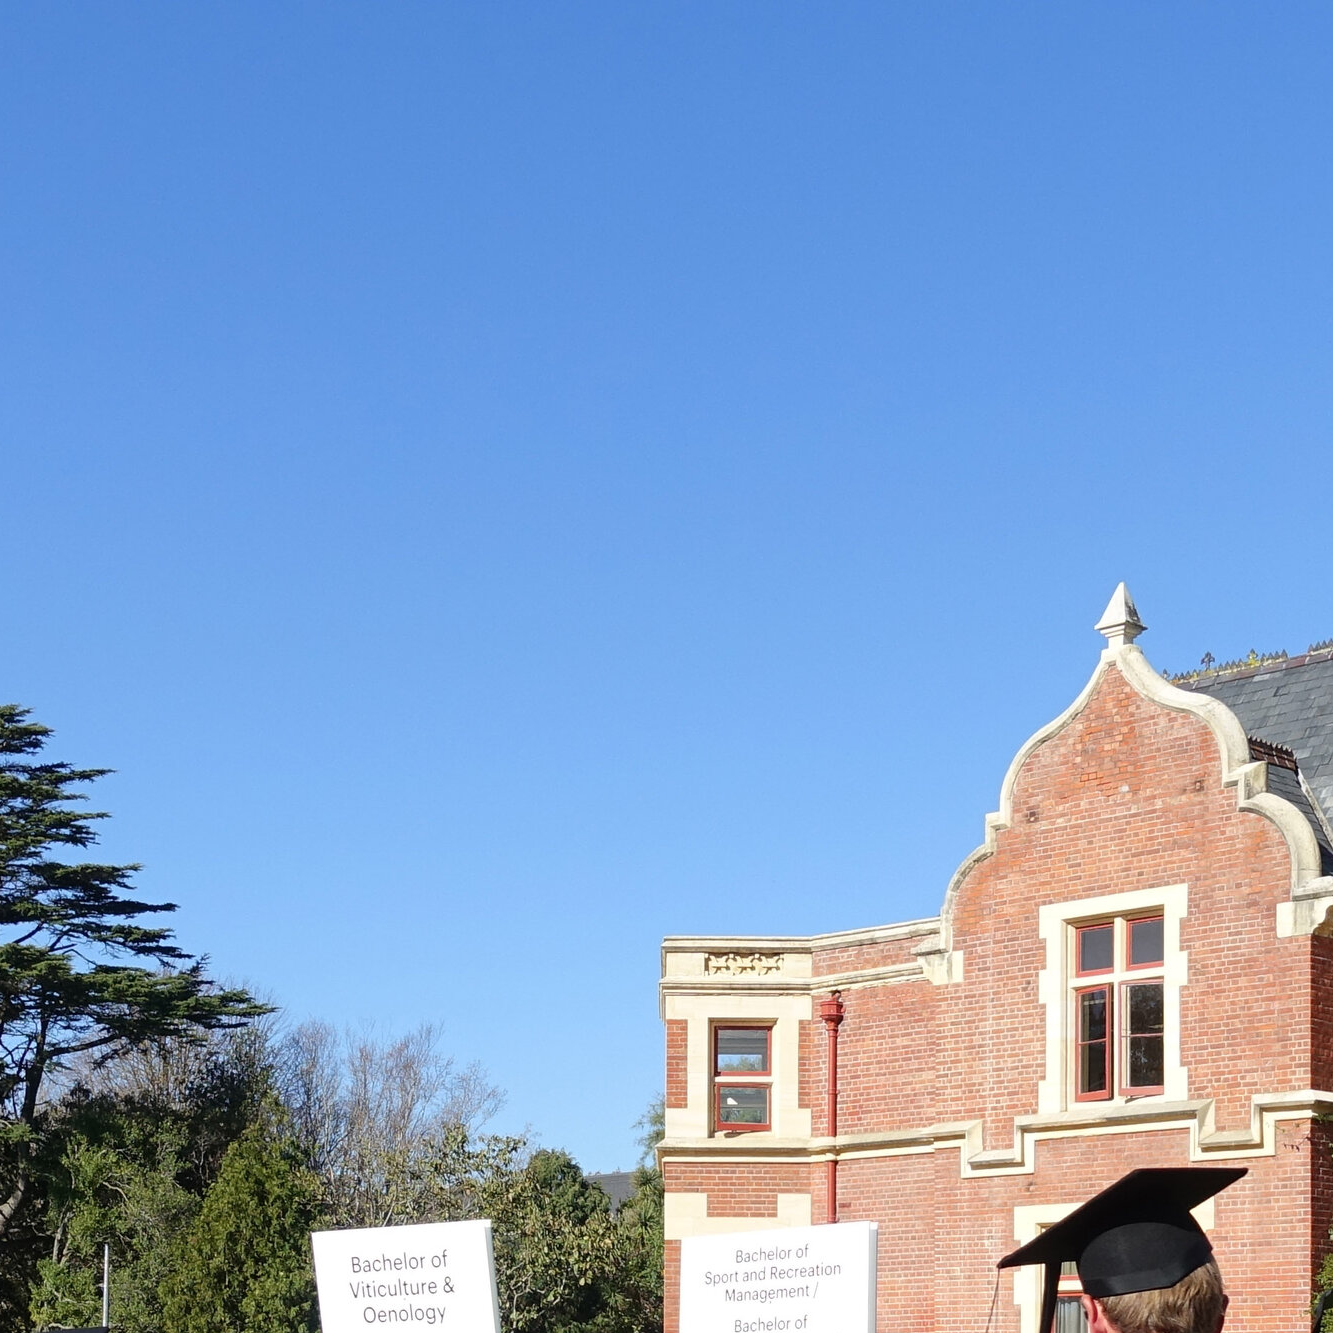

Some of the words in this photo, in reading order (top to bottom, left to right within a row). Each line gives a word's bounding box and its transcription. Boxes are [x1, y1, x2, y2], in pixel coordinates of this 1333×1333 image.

[351, 1252, 425, 1273] Bachelor
[431, 1249, 447, 1268] of
[735, 1246, 792, 1263] Bachelor
[796, 1243, 809, 1258] of
[705, 1271, 739, 1286] Sport
[742, 1266, 765, 1282] and
[770, 1262, 841, 1280] Recreation
[349, 1278, 437, 1298] Viticulture
[443, 1276, 455, 1293] &
[725, 1285, 810, 1303] Management
[363, 1304, 446, 1324] Oenology
[734, 1316, 791, 1333] Bachelor
[795, 1314, 808, 1329] of
